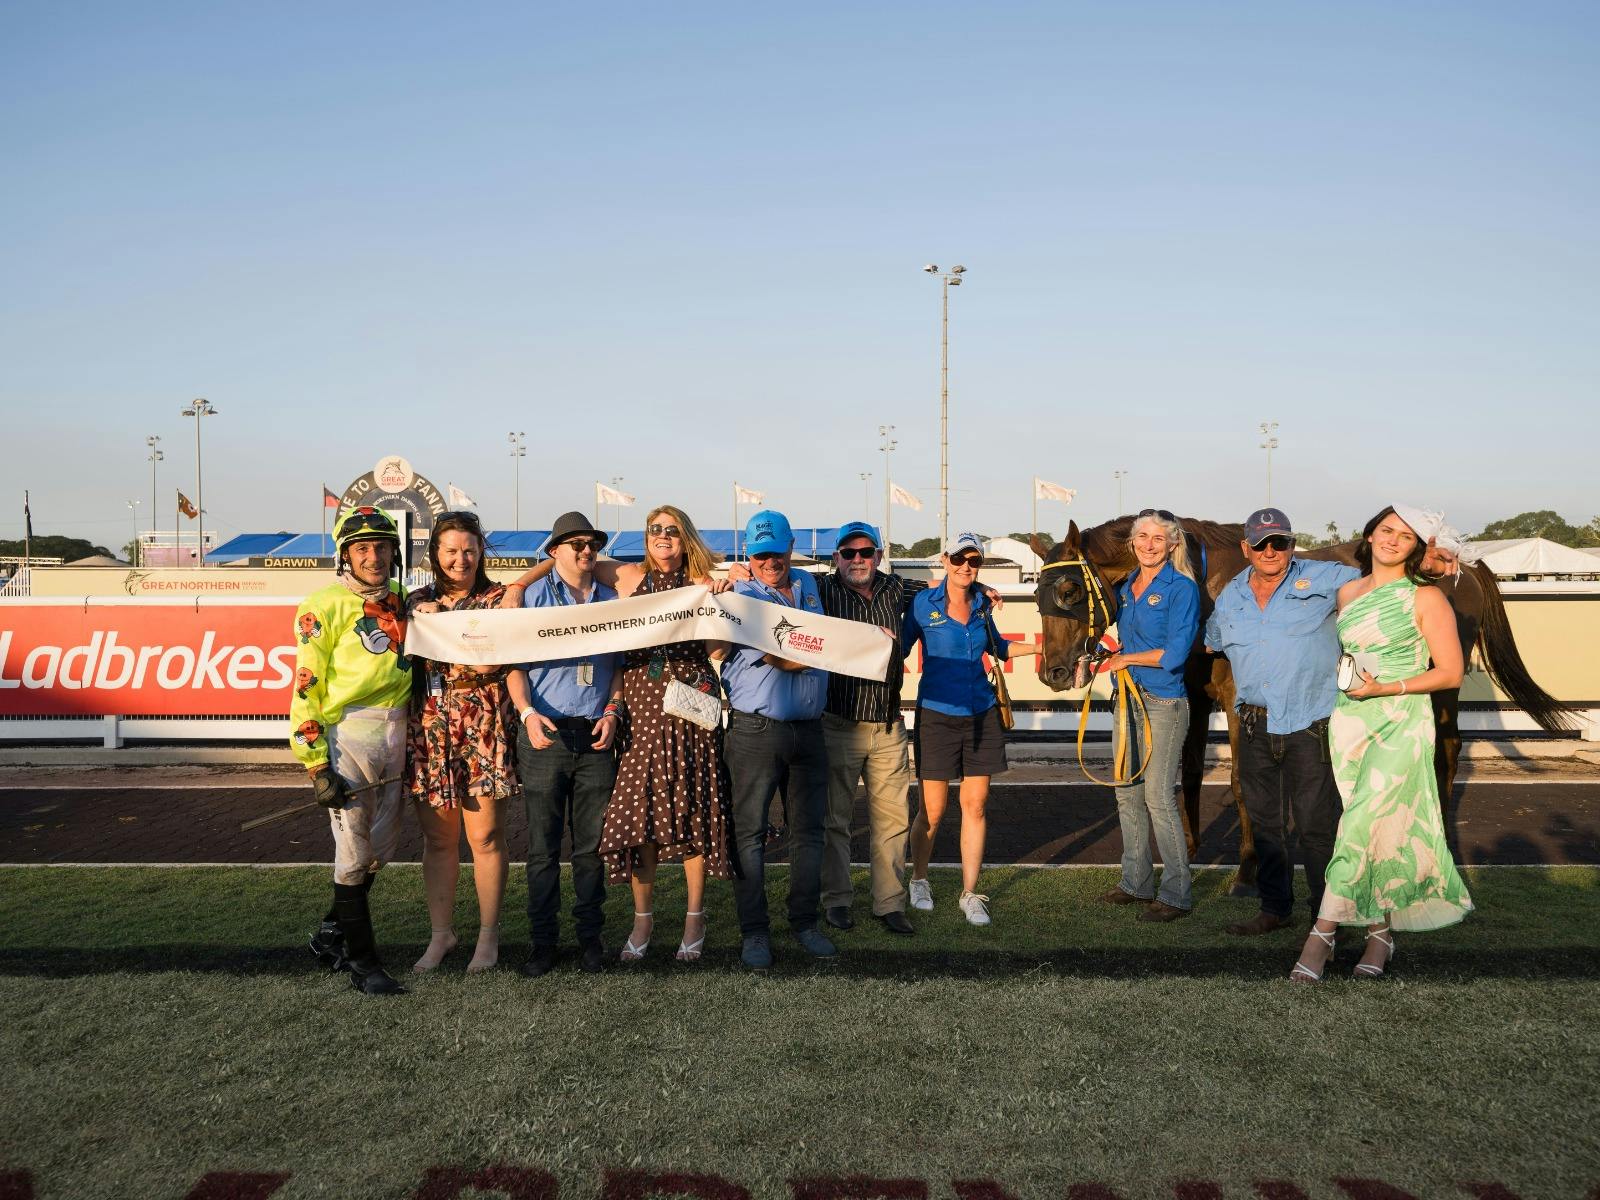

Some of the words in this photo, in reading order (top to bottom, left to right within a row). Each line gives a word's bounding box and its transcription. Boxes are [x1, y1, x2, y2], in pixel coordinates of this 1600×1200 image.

[351, 479, 370, 496] TO
[264, 558, 318, 568] DARWIN
[484, 558, 529, 567] TRALIA
[141, 581, 178, 590] GREAT
[180, 581, 240, 590] NORTHERN
[537, 626, 578, 638] GREAT
[581, 617, 646, 635] NORTHERN
[648, 608, 695, 626] DARWIN
[697, 606, 717, 617] CUP
[718, 609, 743, 626] 2023
[789, 631, 825, 646] GREAT
[788, 640, 823, 652] NORTHERN
[0, 630, 298, 690] Ladbrokes
